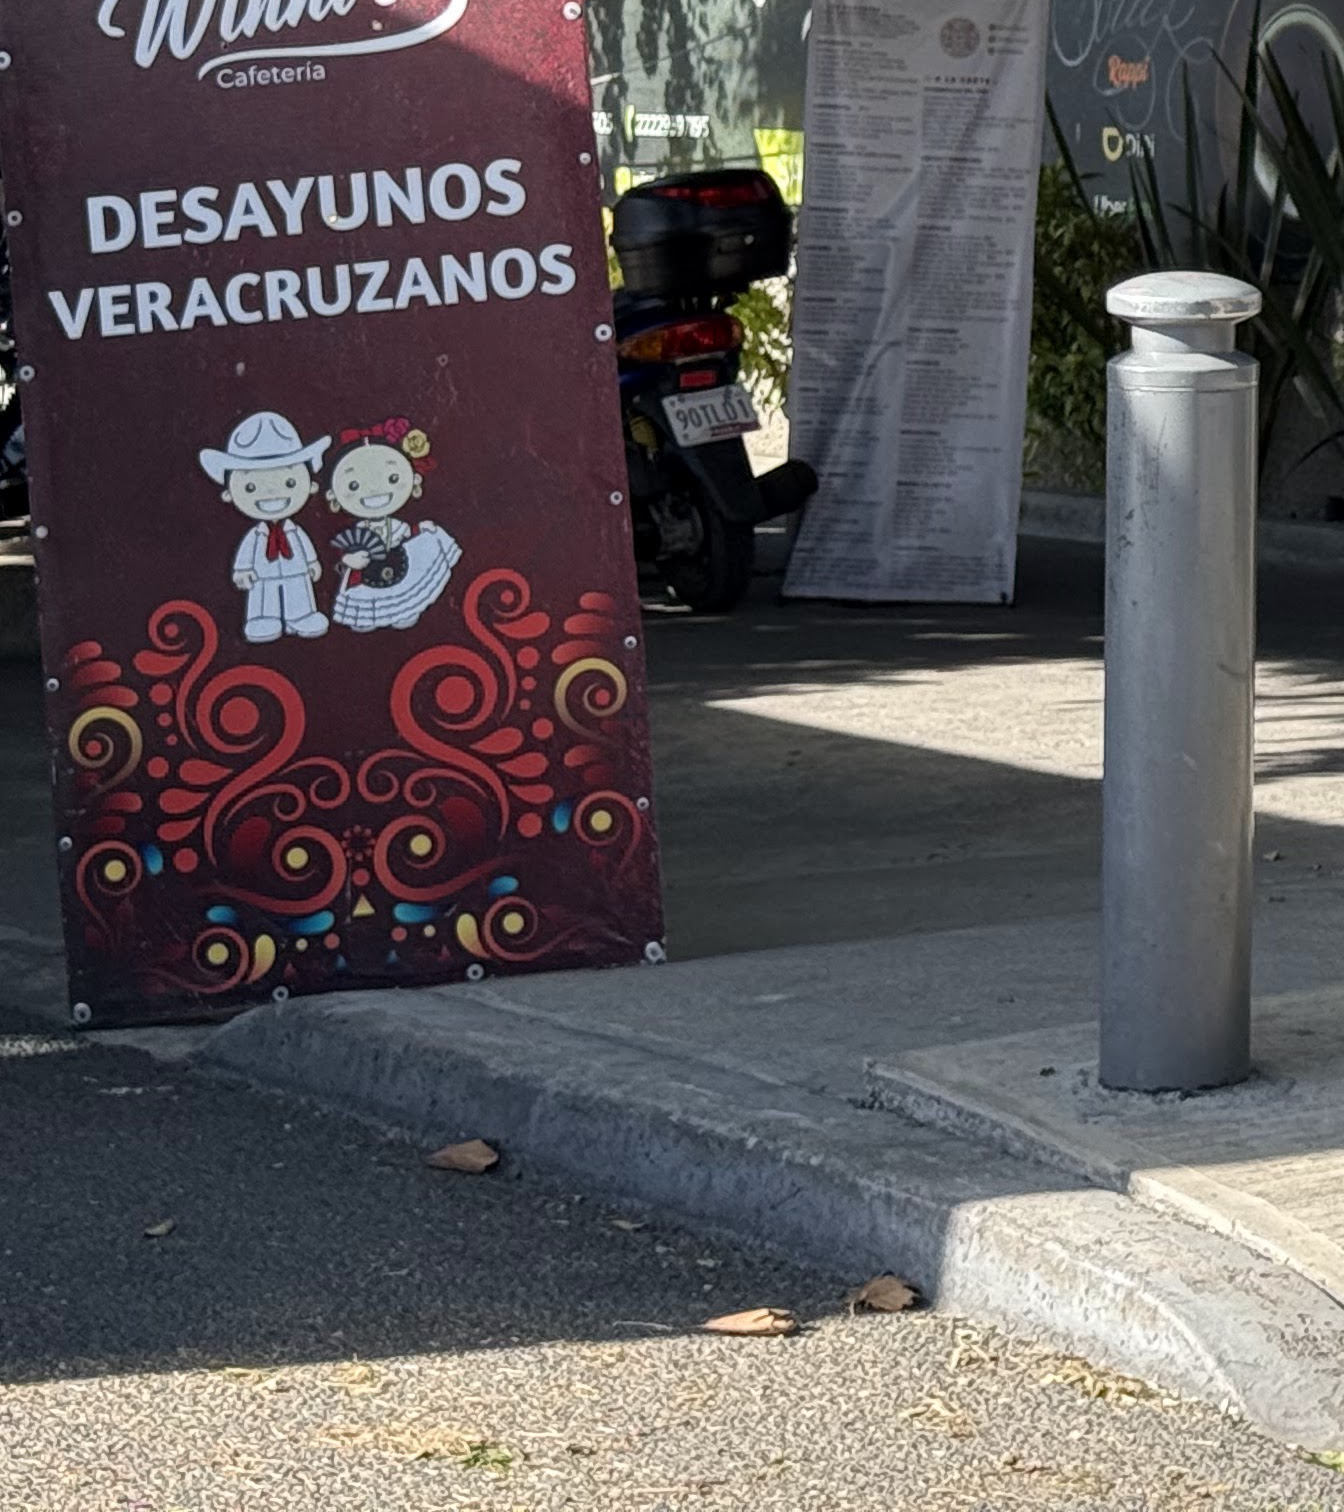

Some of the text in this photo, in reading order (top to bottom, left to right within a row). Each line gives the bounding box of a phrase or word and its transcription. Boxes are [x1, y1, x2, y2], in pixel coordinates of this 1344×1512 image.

[215, 61, 327, 90] Cafetería
[86, 158, 526, 255] DESAYUNOS
[49, 244, 577, 340] VERACRUZANOS
